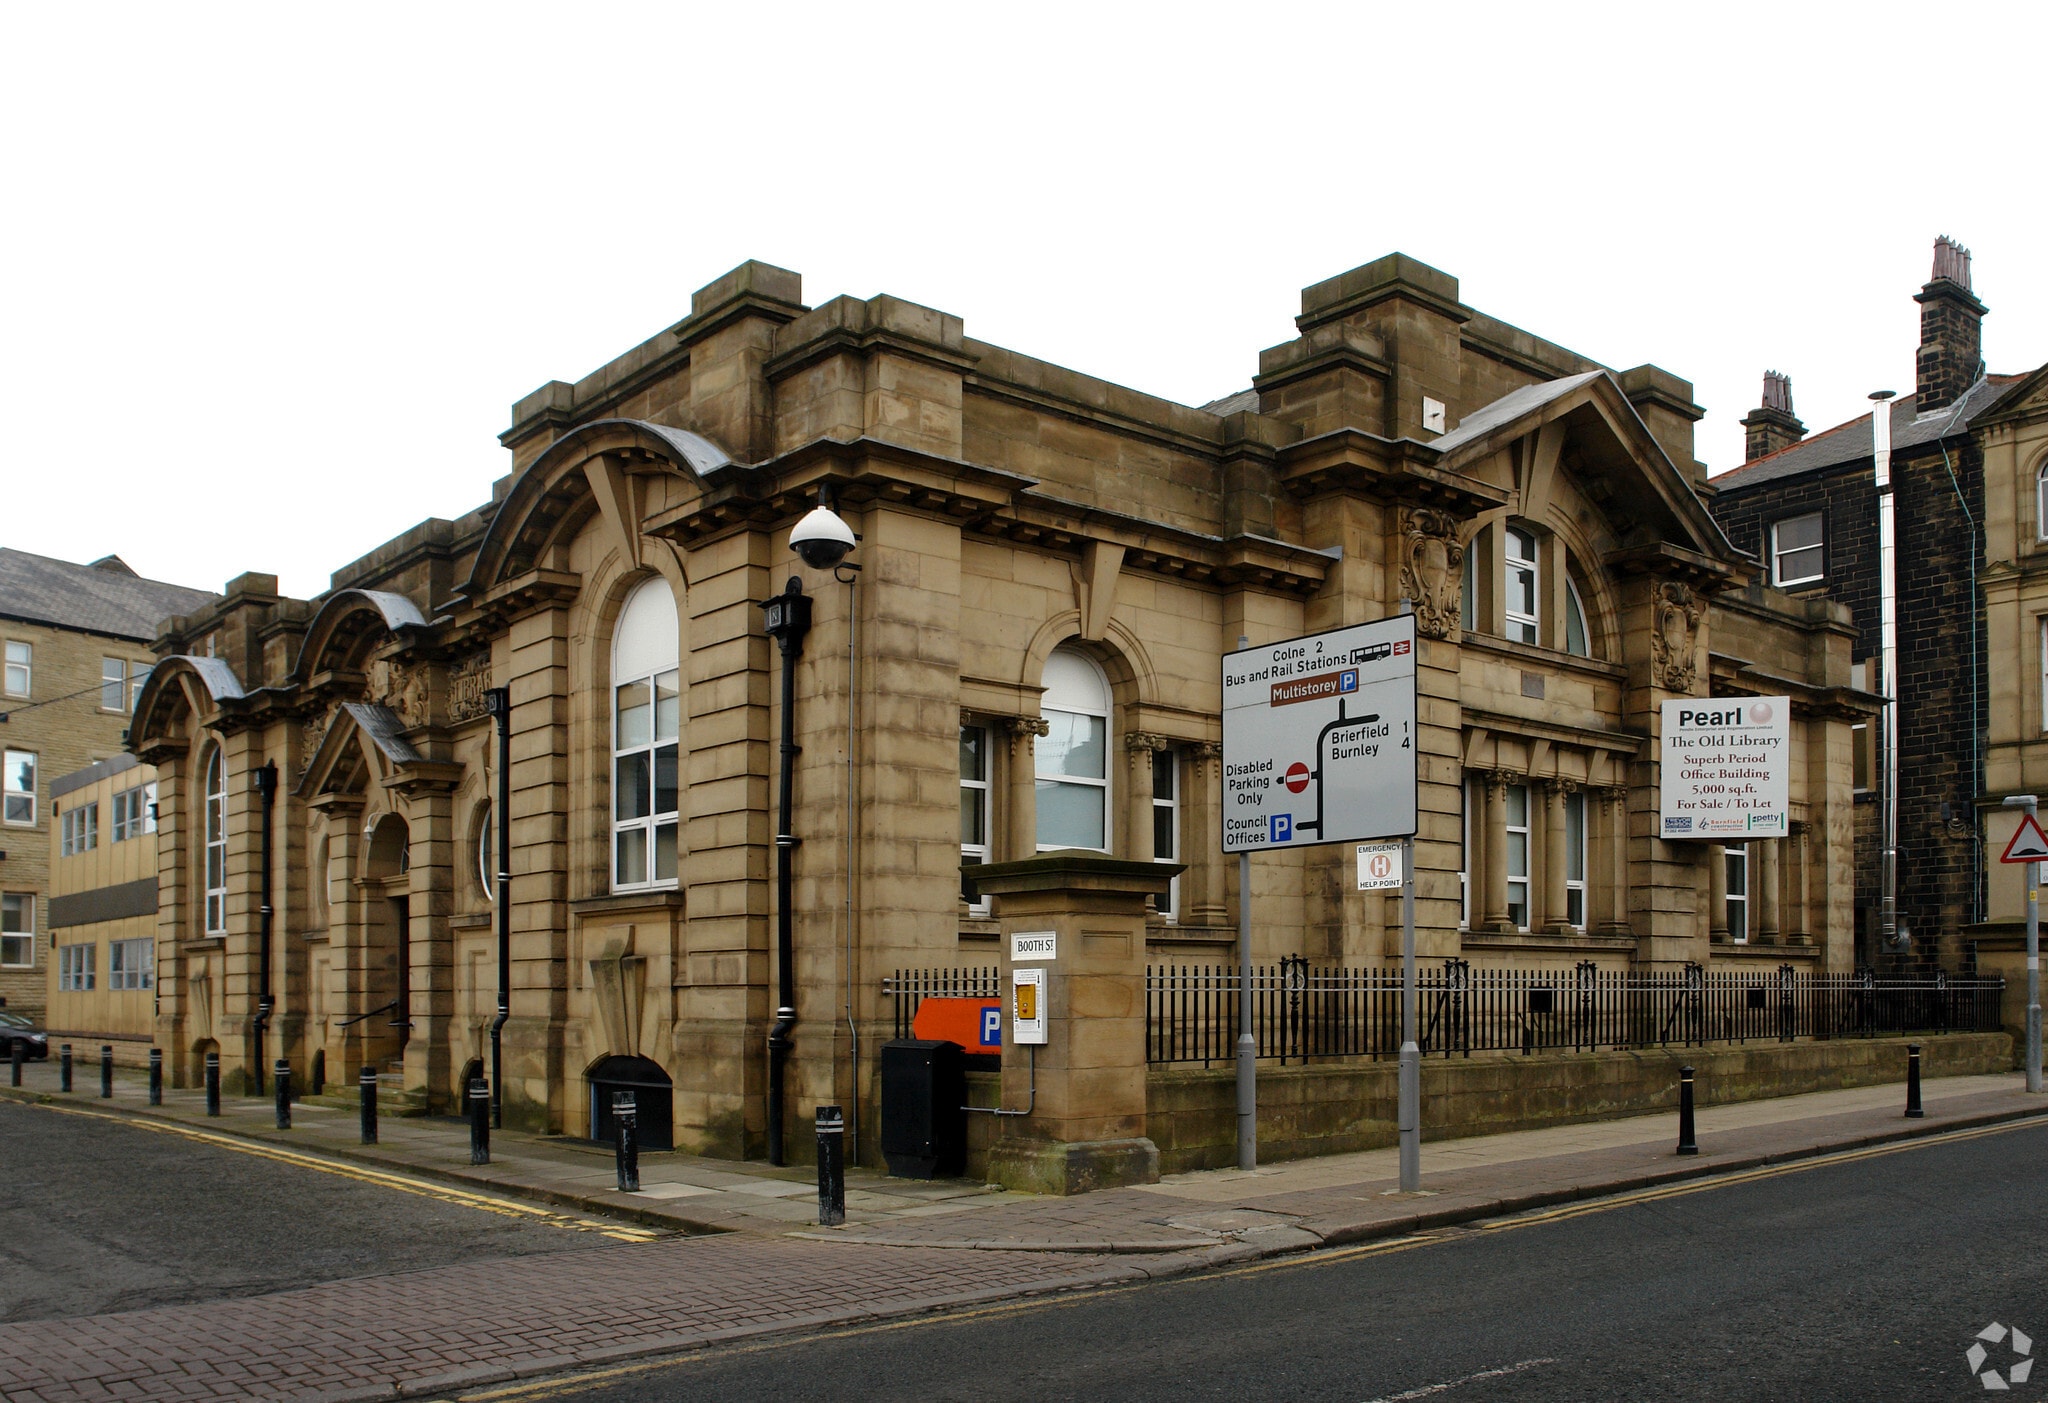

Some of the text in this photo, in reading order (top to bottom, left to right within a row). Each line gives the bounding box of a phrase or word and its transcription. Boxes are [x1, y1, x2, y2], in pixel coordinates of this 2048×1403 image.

[1273, 641, 1323, 662] Colne 2
[1226, 654, 1347, 687] Bus and Rail Stations
[1273, 674, 1354, 701] Multistorey P
[1680, 707, 1741, 726] Pearl
[1332, 721, 1408, 744] Brierfield 1
[1332, 737, 1410, 760] Burnley 4
[1669, 734, 1781, 748] The Old Library
[1226, 758, 1273, 776] Disabled
[1684, 753, 1766, 767] Superb Period
[1680, 768, 1770, 781] Office Building
[1229, 776, 1270, 791] Parking
[1692, 783, 1757, 796] 5,000 sq.ft.
[1237, 792, 1263, 806] Only
[1677, 799, 1697, 809] For
[1700, 799, 1723, 809] Sale
[1734, 799, 1749, 808] To
[1753, 798, 1771, 808] Let
[1756, 814, 1779, 822] petty
[1227, 815, 1289, 840] Council P
[1226, 832, 1265, 845] Offices
[1358, 844, 1400, 853] EMERGENCY
[1374, 857, 1387, 876] H
[1018, 940, 1044, 952] BOOTH
[985, 1012, 1000, 1041] P
